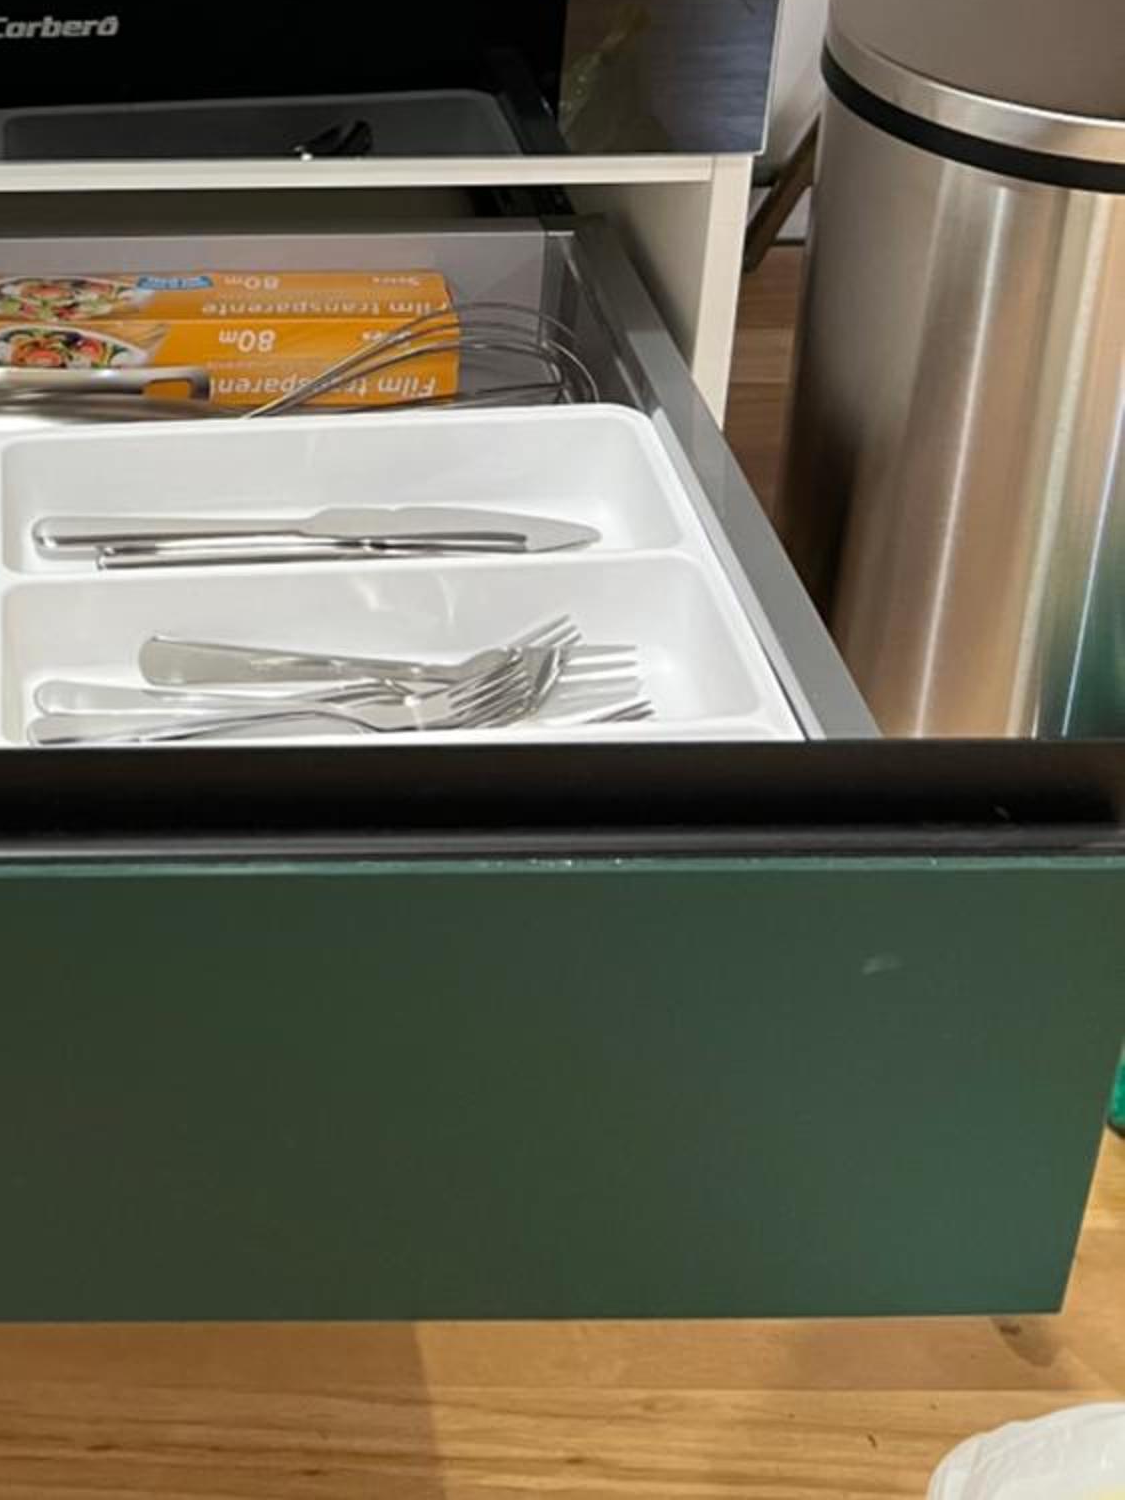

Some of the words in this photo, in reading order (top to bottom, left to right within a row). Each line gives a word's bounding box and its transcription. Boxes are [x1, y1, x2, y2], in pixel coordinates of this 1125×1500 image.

[201, 299, 380, 318] transparente
[218, 328, 277, 353] 80m
[377, 374, 437, 398] Film
